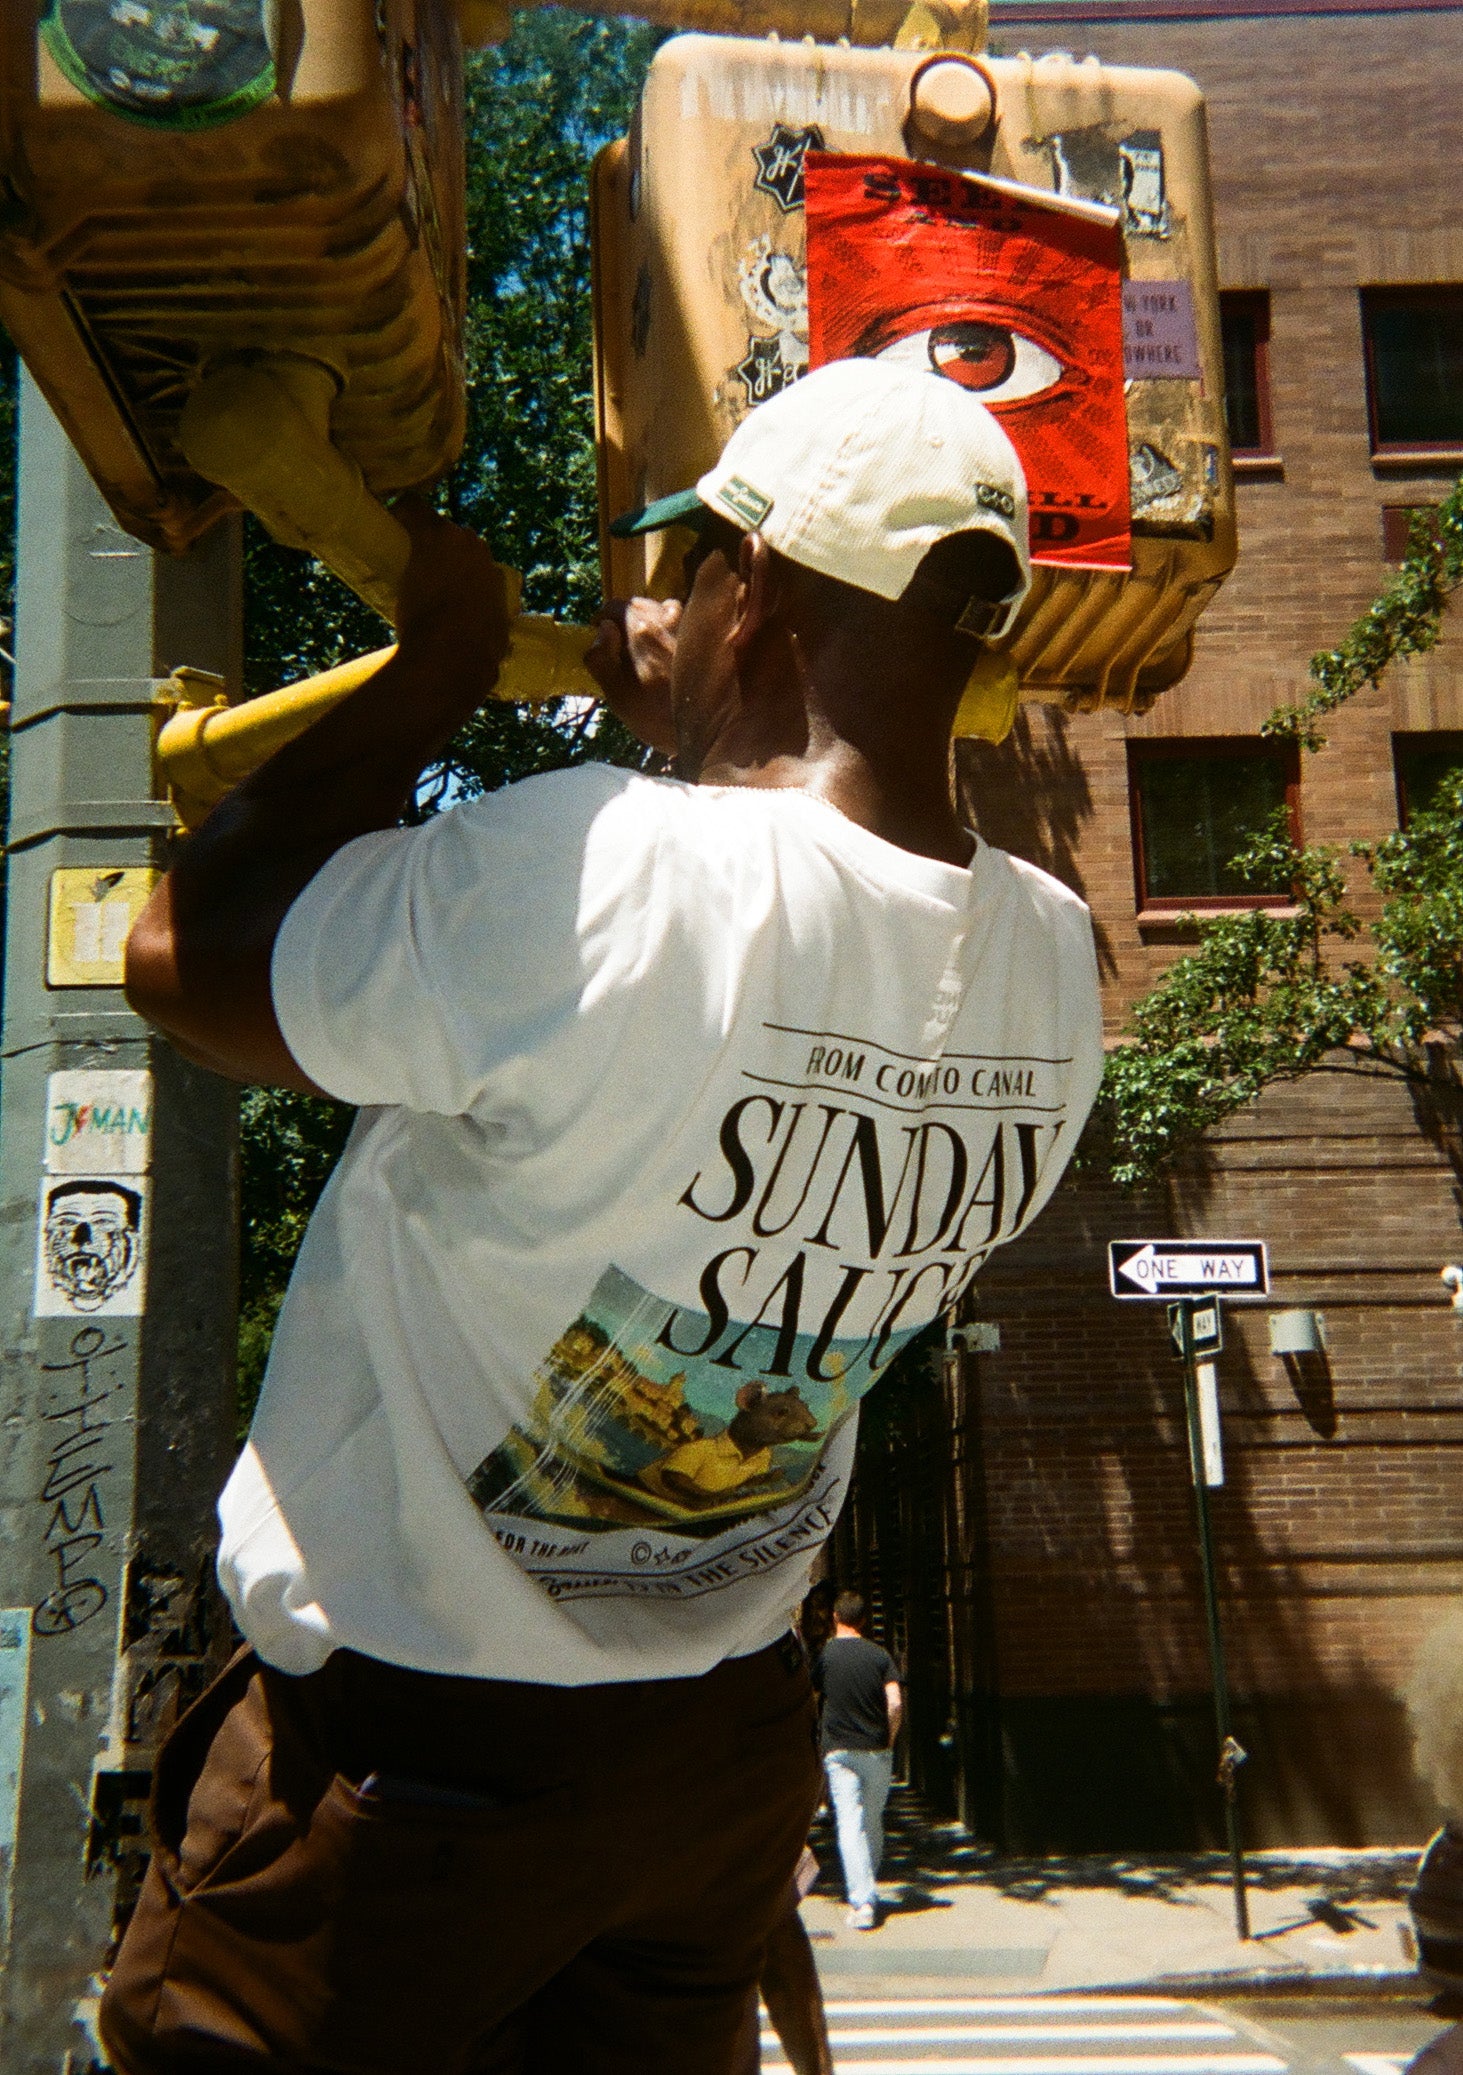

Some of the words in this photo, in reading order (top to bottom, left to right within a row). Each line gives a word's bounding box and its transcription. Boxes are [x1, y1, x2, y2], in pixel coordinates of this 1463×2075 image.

[864, 174, 1052, 214] SEE
[1123, 344, 1182, 364] OWHERE
[971, 1068, 1037, 1098] CANAL
[677, 1094, 1067, 1260] SUNDAY
[1136, 1258, 1178, 1279] ONE
[1201, 1258, 1245, 1279] WAY
